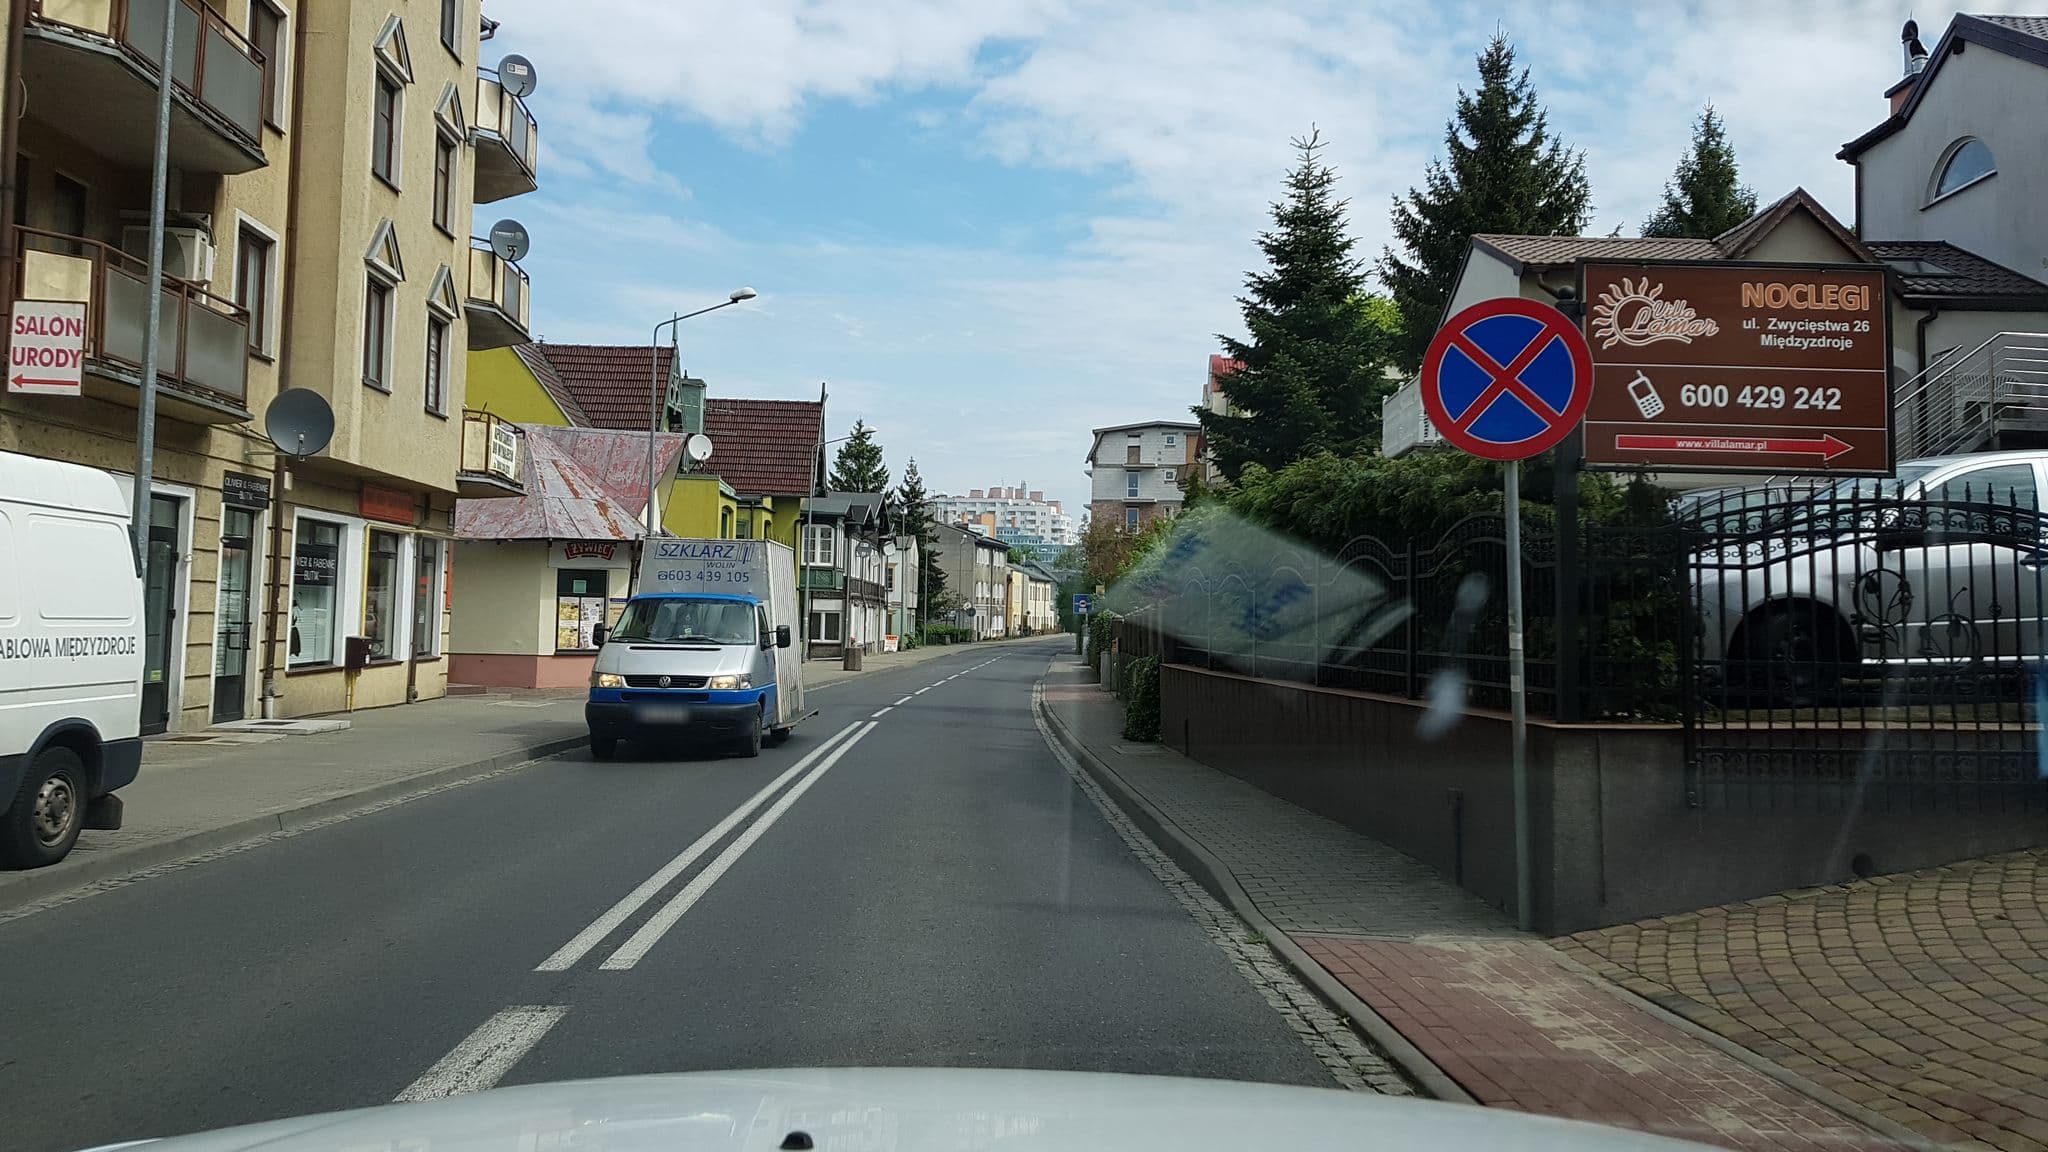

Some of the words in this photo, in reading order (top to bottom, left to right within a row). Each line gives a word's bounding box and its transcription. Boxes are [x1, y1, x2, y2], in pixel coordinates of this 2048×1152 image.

[1741, 282, 1870, 311] NOCLEGI
[1652, 299, 1697, 320] Villa
[14, 315, 81, 337] SALON
[1622, 306, 1720, 337] Lamar
[1743, 317, 1760, 329] ul.
[1767, 317, 1850, 333] Zwycięstwa
[1853, 320, 1870, 332] 26
[1760, 334, 1854, 350] Międzyzdroje
[12, 346, 82, 369] URODY
[1680, 384, 1729, 408] 600
[1737, 385, 1786, 409] 429
[1793, 387, 1842, 410] 242
[1676, 439, 1768, 451] www.villalamar.pl
[658, 543, 735, 559] SZKLARZ
[706, 561, 736, 569] WOLIN
[668, 570, 692, 581] 603
[696, 571, 721, 582] 439
[727, 571, 750, 582] 105
[55, 636, 136, 662] MIĘDZYZDROJE
